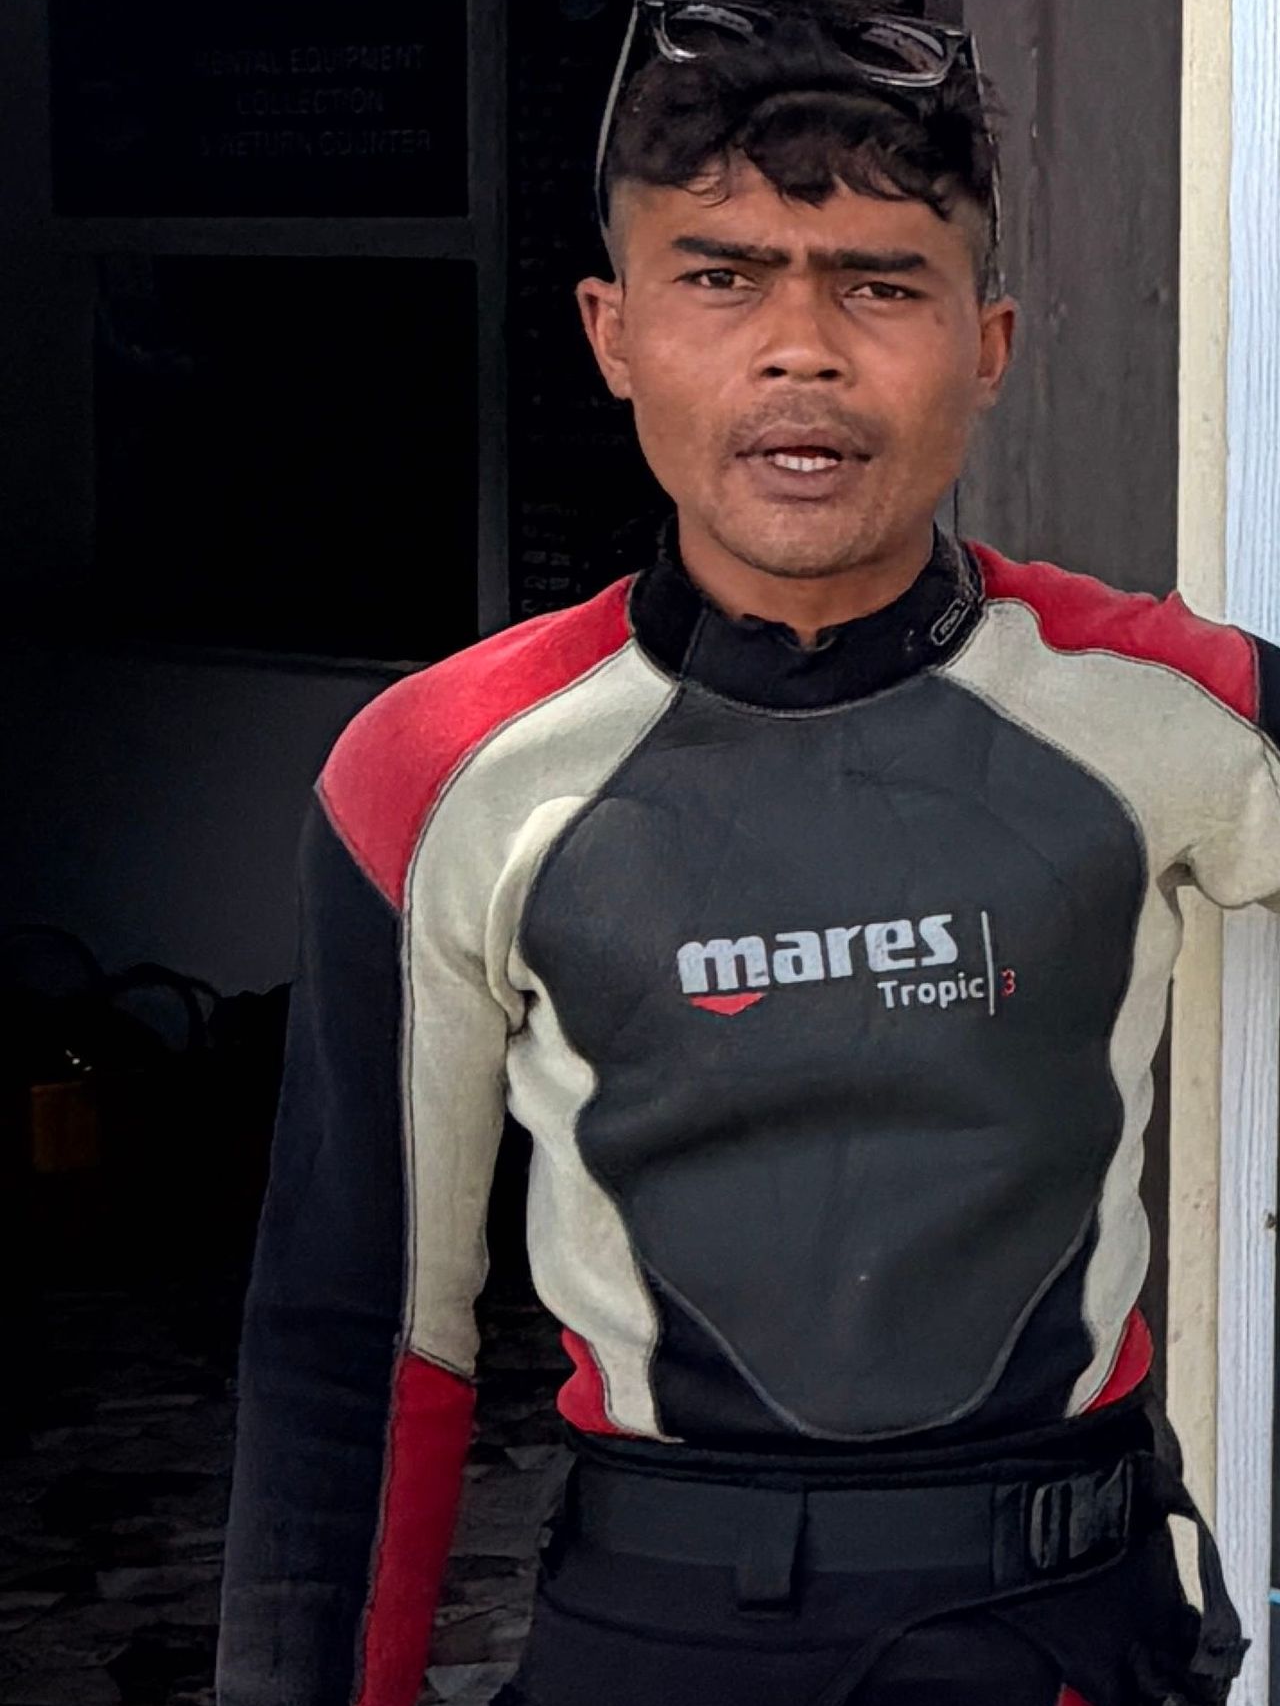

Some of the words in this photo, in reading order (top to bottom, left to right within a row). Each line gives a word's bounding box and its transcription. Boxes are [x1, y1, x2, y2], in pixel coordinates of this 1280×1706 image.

[676, 913, 960, 995] mares
[876, 971, 985, 1010] Tropic
[999, 967, 1017, 997] 3
